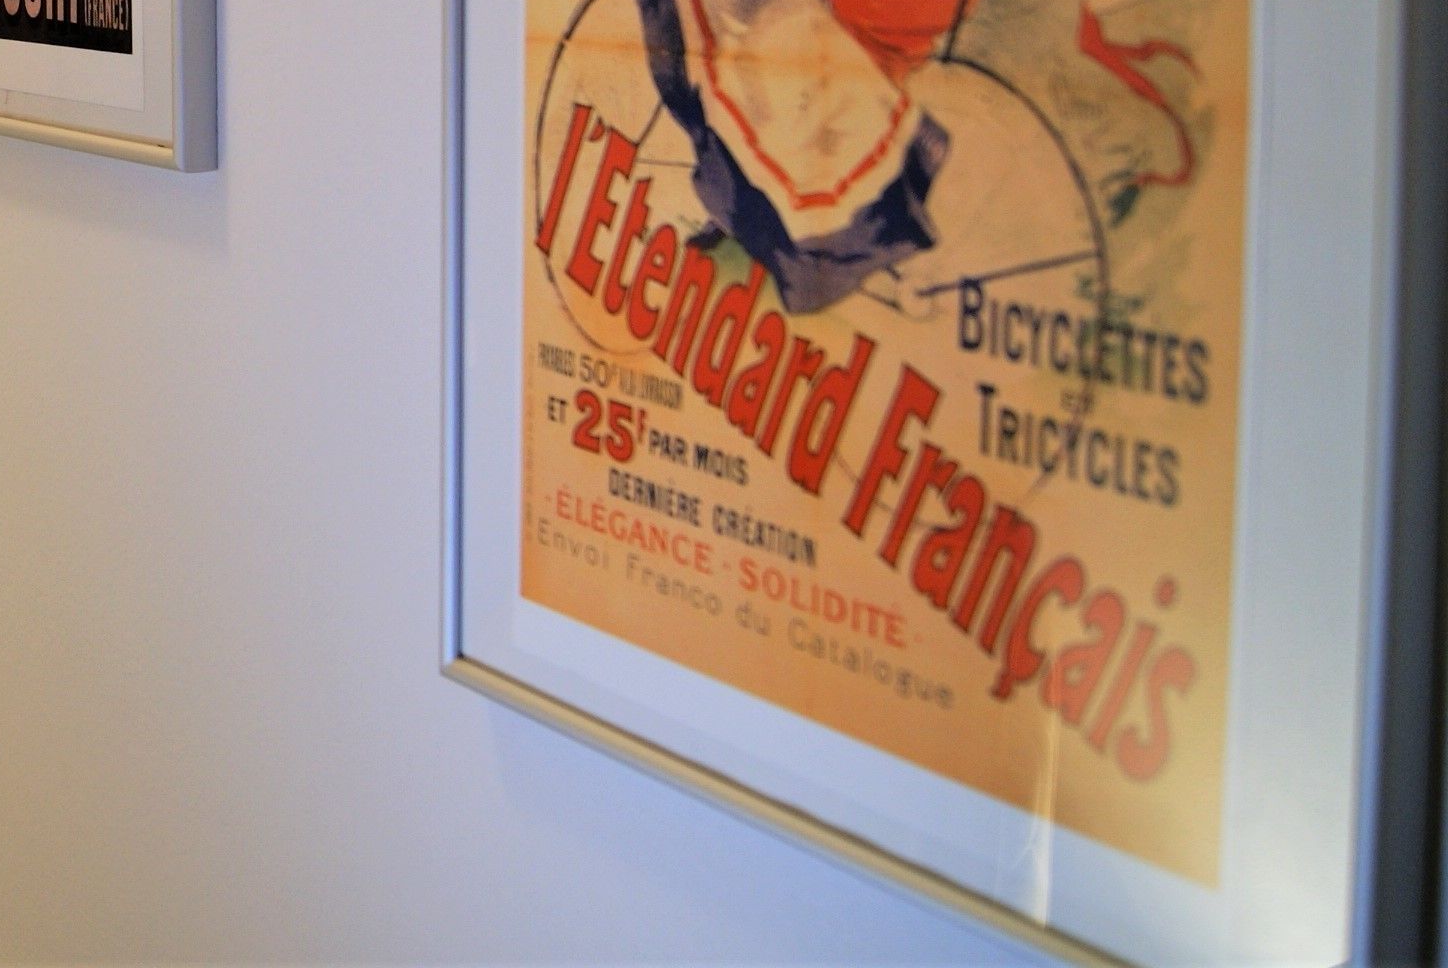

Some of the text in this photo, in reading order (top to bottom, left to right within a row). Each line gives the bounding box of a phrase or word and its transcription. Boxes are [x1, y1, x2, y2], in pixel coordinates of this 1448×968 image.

[959, 278, 1210, 405] BICYCLETTES
[547, 395, 568, 424] ET
[648, 428, 688, 467] PAR
[693, 442, 749, 486] MOIS
[977, 383, 1180, 508] TRICYCLES
[537, 517, 954, 710] Envoi Franco du Catalogue
[842, 362, 1198, 784] Français
